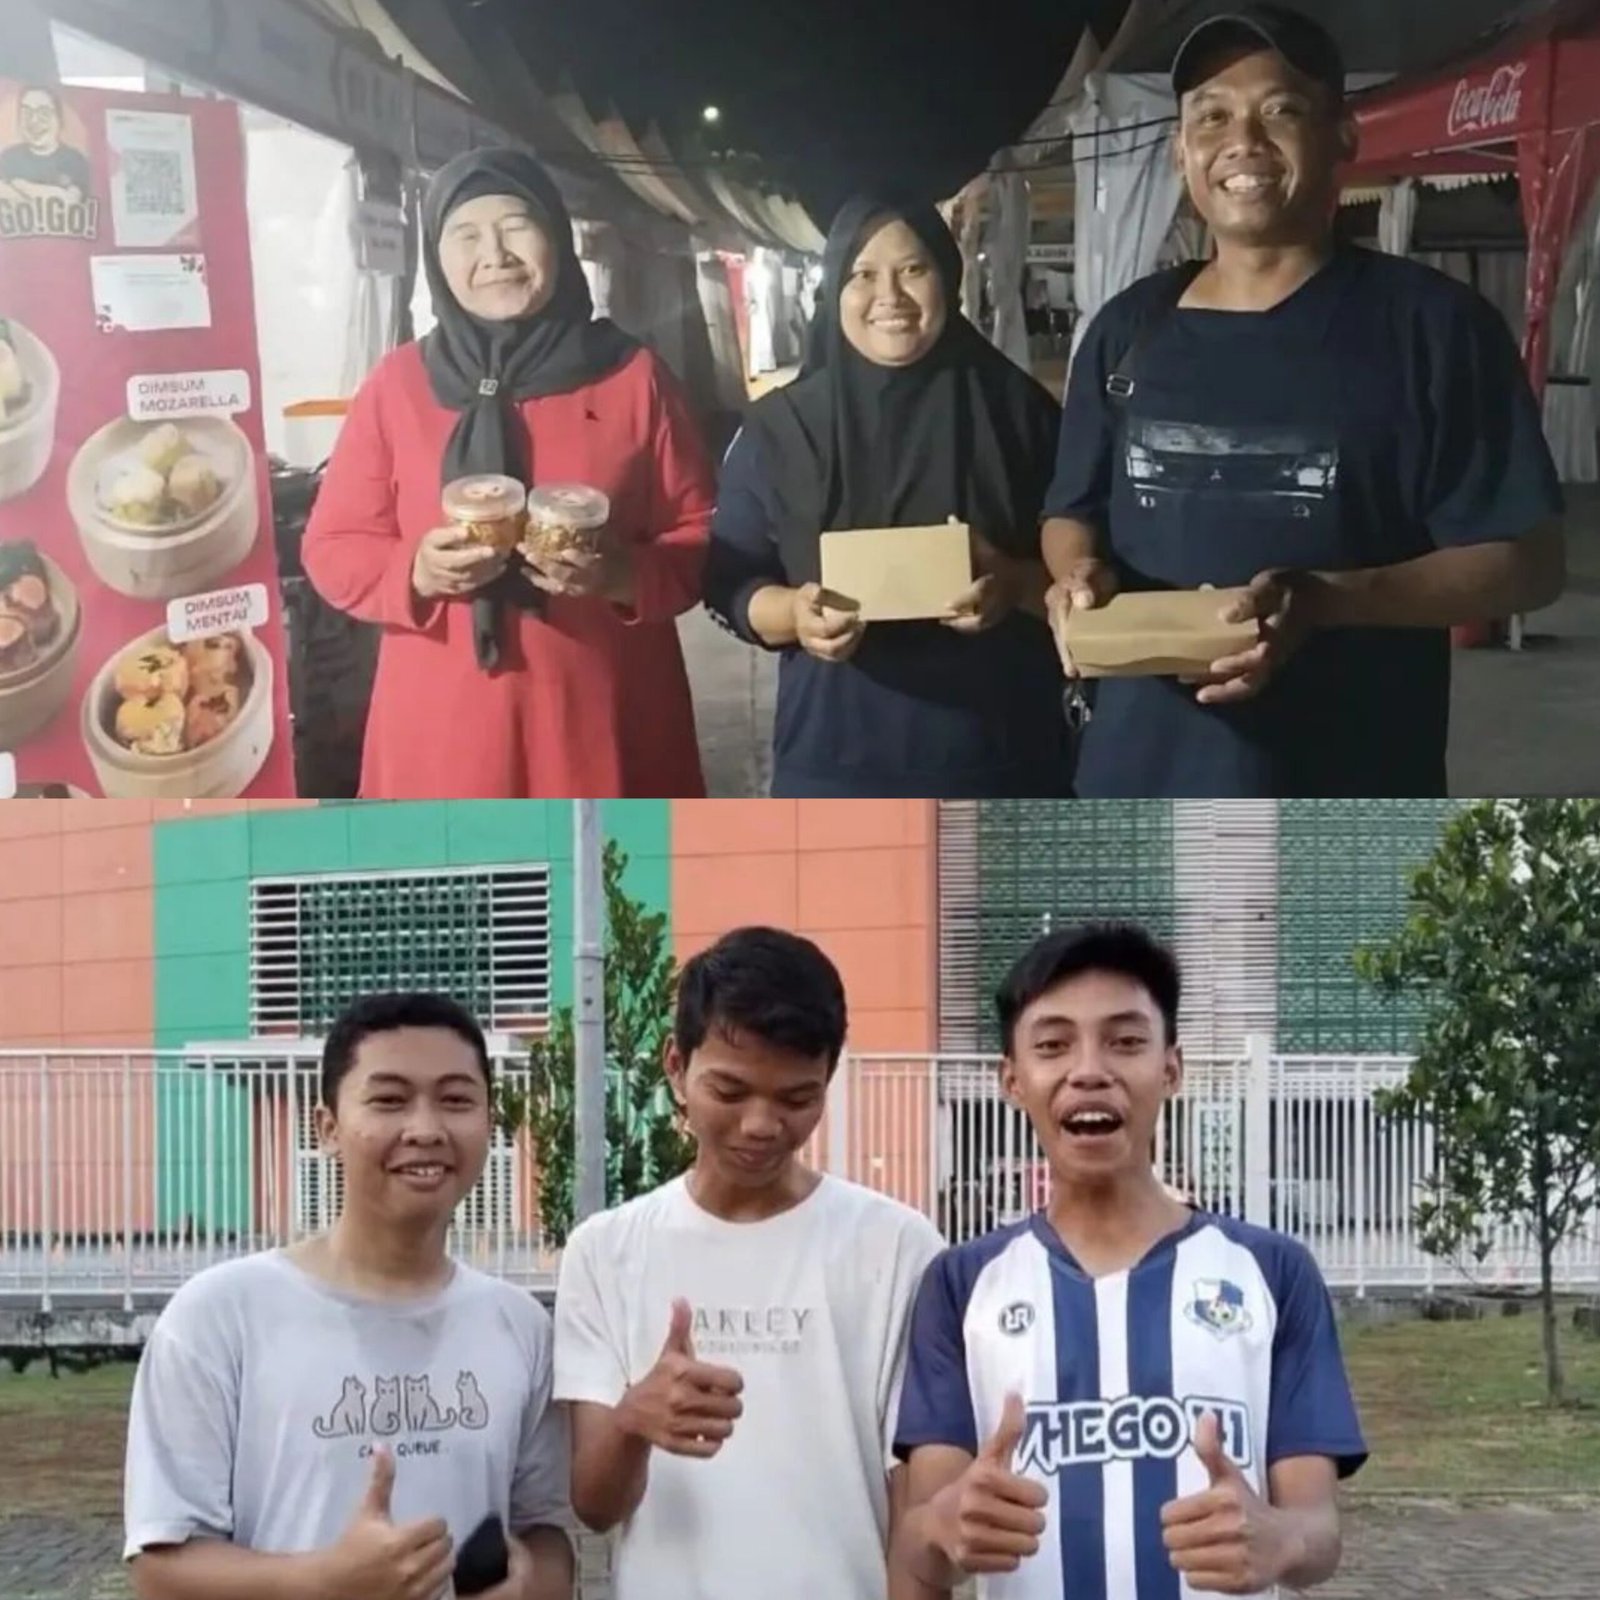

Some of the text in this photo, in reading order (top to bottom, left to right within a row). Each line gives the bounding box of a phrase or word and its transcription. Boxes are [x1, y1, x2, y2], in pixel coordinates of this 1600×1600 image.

[138, 378, 206, 395] DIMSUM
[140, 394, 240, 412] MOZARELLA
[185, 591, 251, 614] DIMSUM
[186, 610, 248, 632] MENTAI
[694, 1307, 811, 1335] AKLEY
